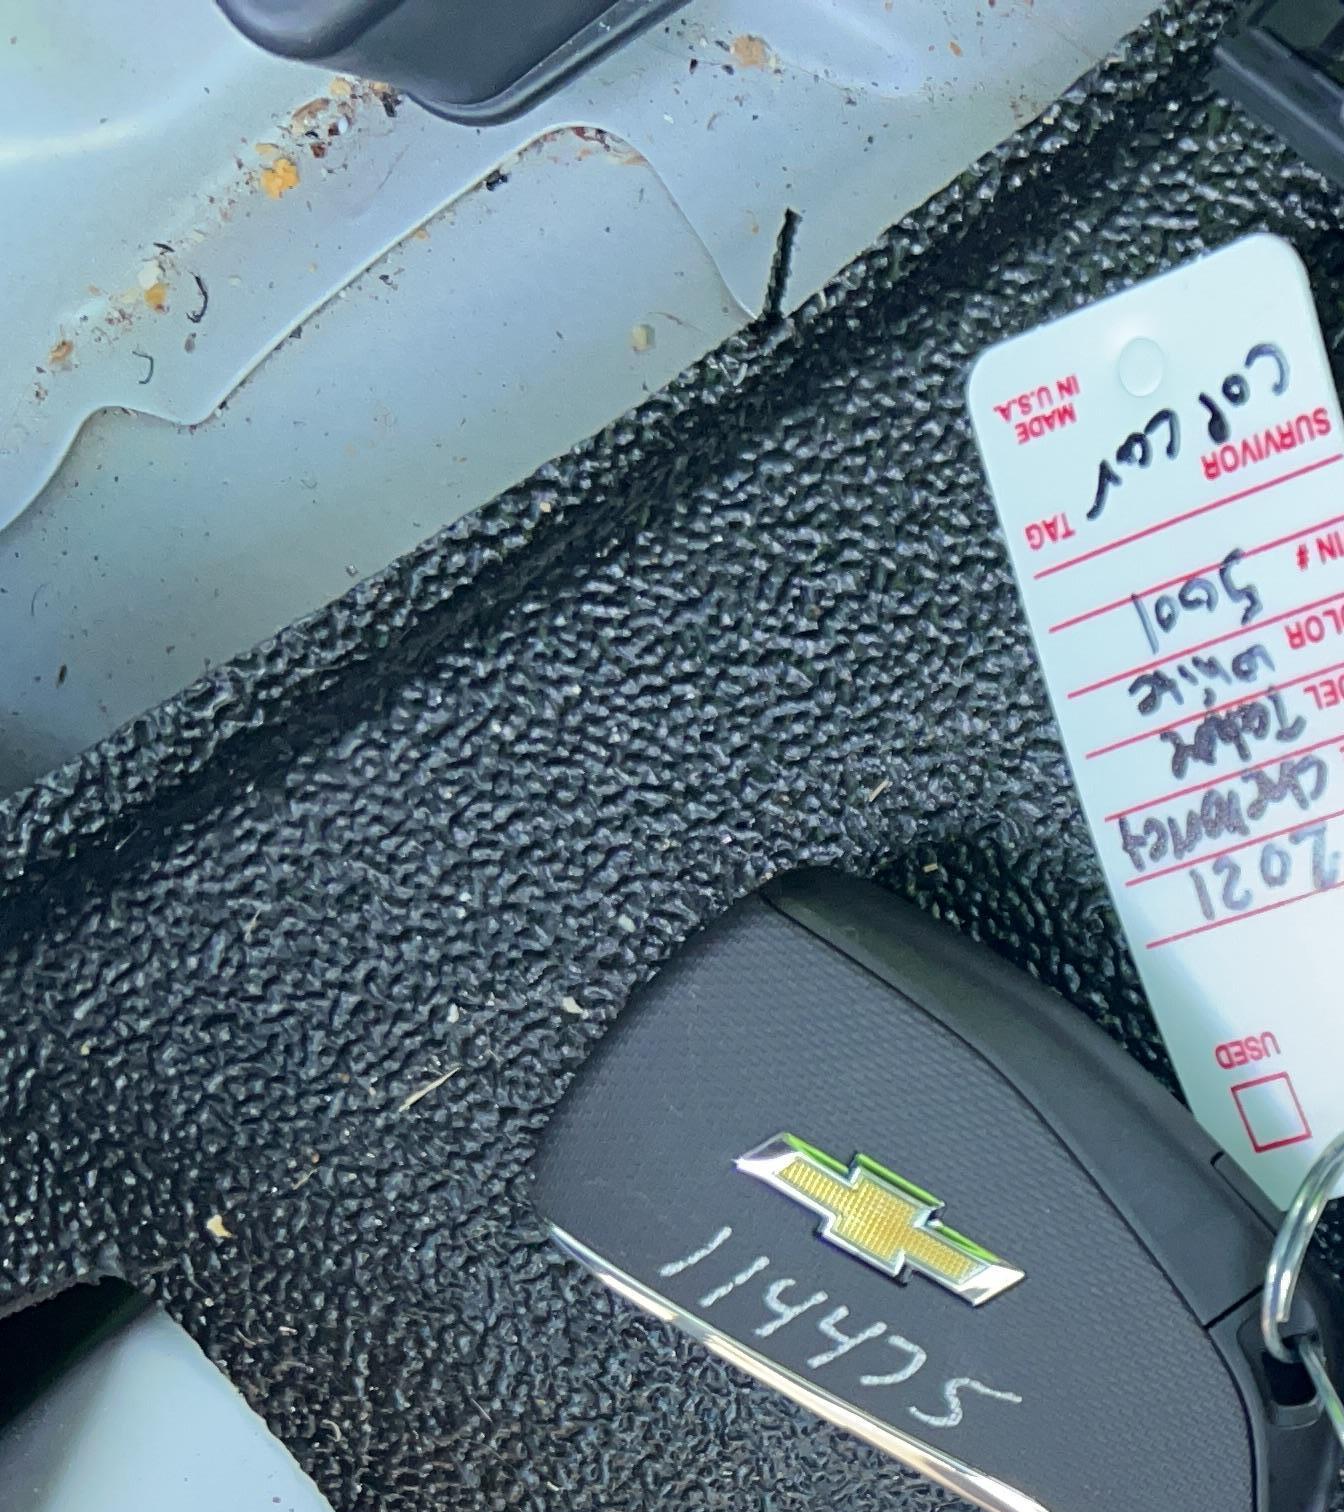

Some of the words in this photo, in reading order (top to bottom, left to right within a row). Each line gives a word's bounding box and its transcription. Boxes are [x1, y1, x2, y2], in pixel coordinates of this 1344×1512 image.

[1055, 374, 1081, 402] IN
[1013, 402, 1078, 446] MADE
[1201, 407, 1333, 480] SURVIVOR
[1024, 511, 1076, 551] TAG
[1295, 543, 1310, 571] #
[1131, 547, 1264, 655] 5001
[1188, 822, 1343, 921] 2021
[1213, 1030, 1283, 1071] USED
